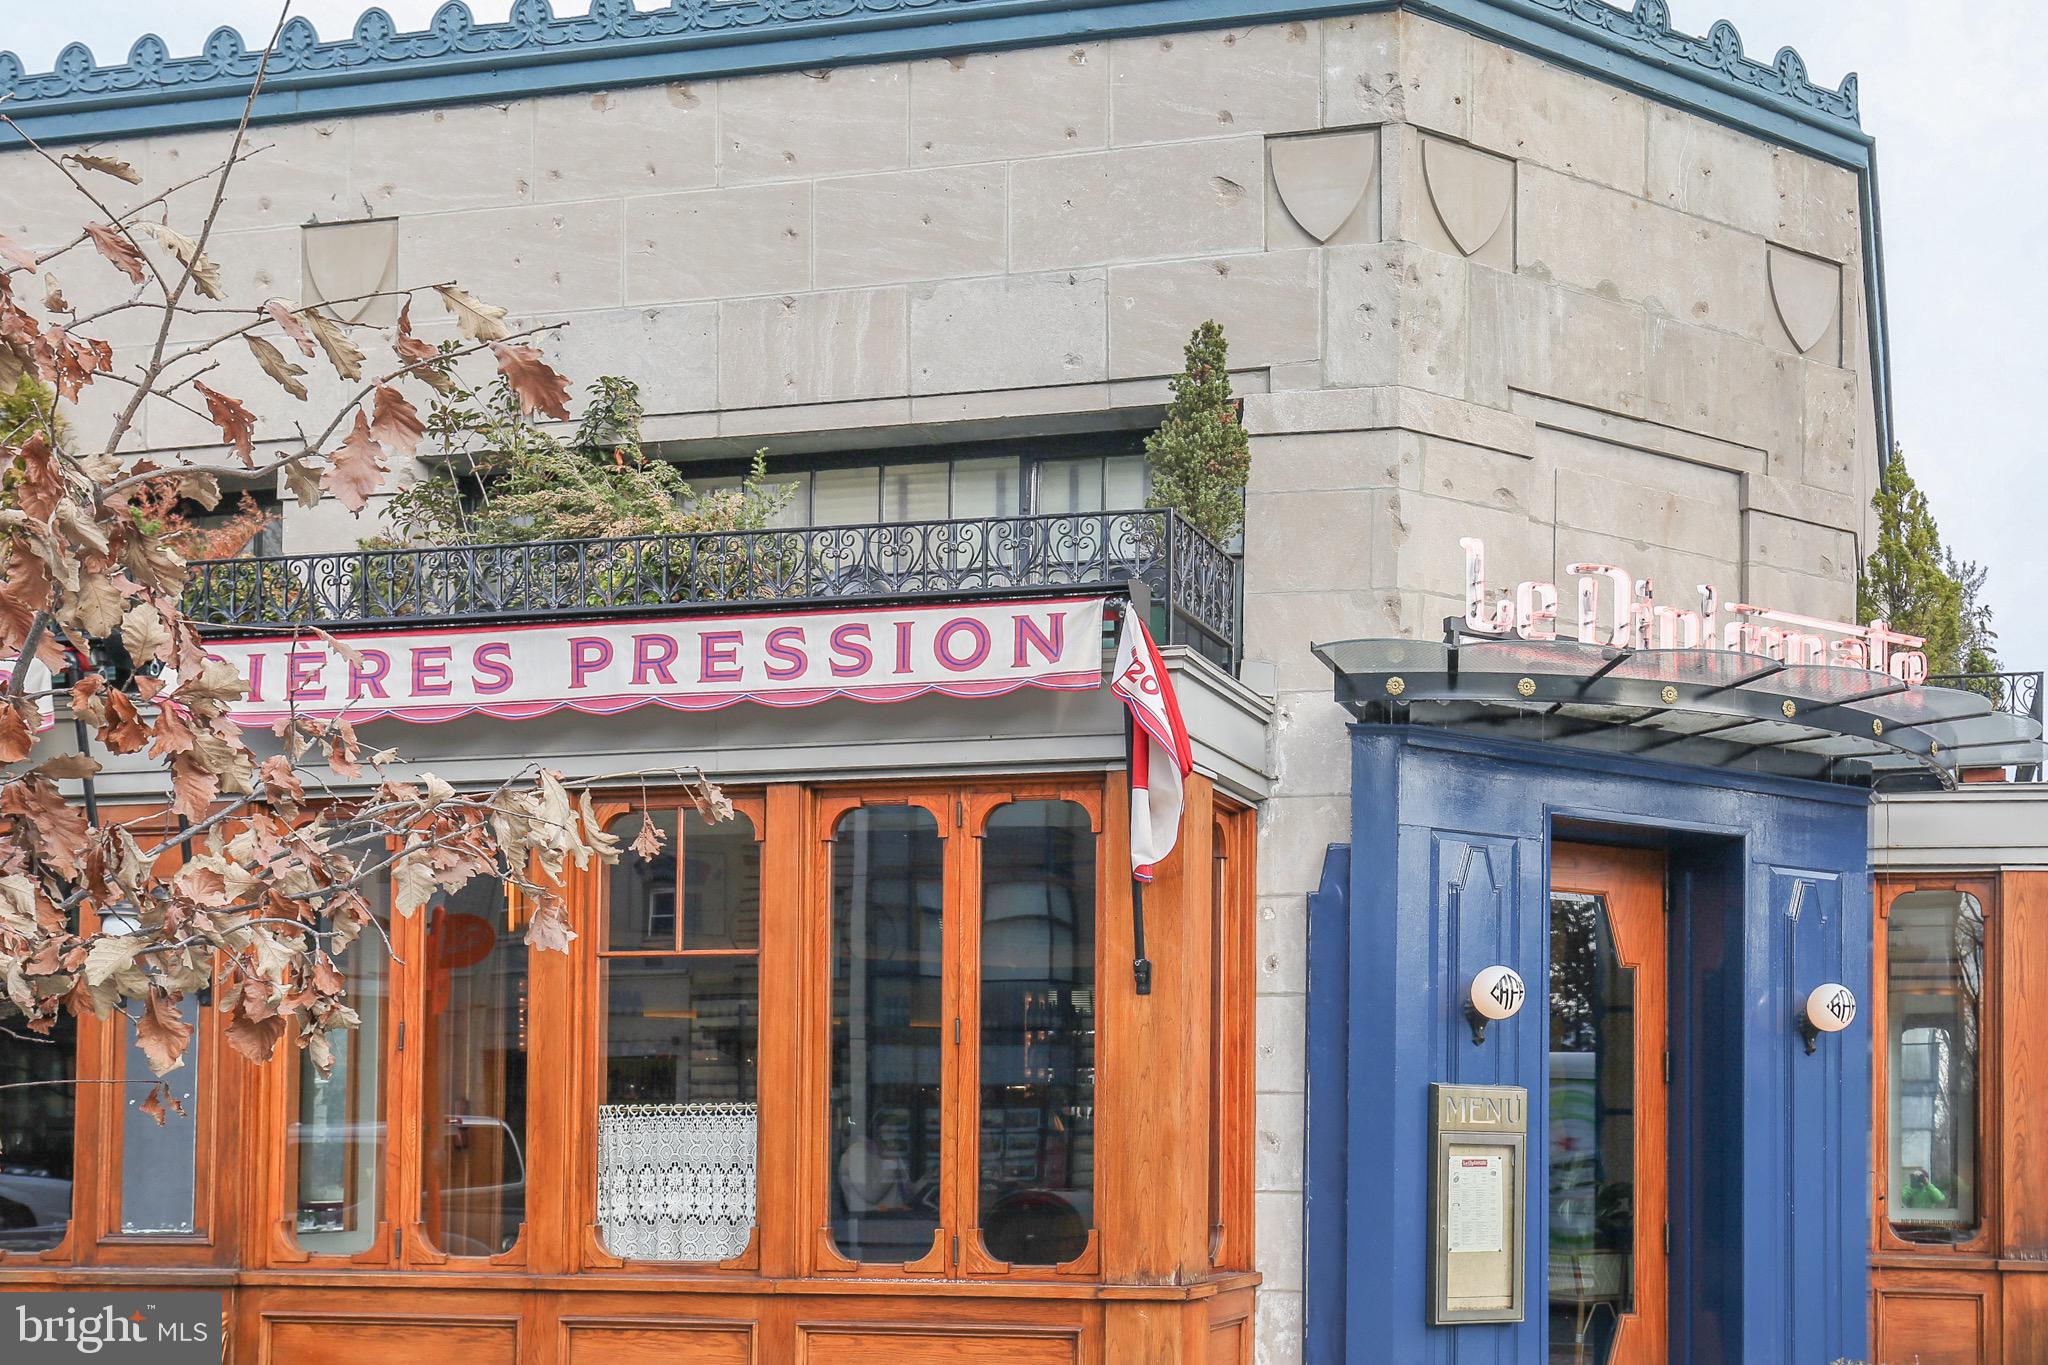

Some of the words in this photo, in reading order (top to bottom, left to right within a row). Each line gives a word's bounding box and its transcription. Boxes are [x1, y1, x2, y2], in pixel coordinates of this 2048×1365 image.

[1459, 536, 1557, 641] Le
[205, 640, 515, 703] IÈRES
[567, 611, 1068, 689] PRESSION
[1446, 1093, 1521, 1125] MENU
